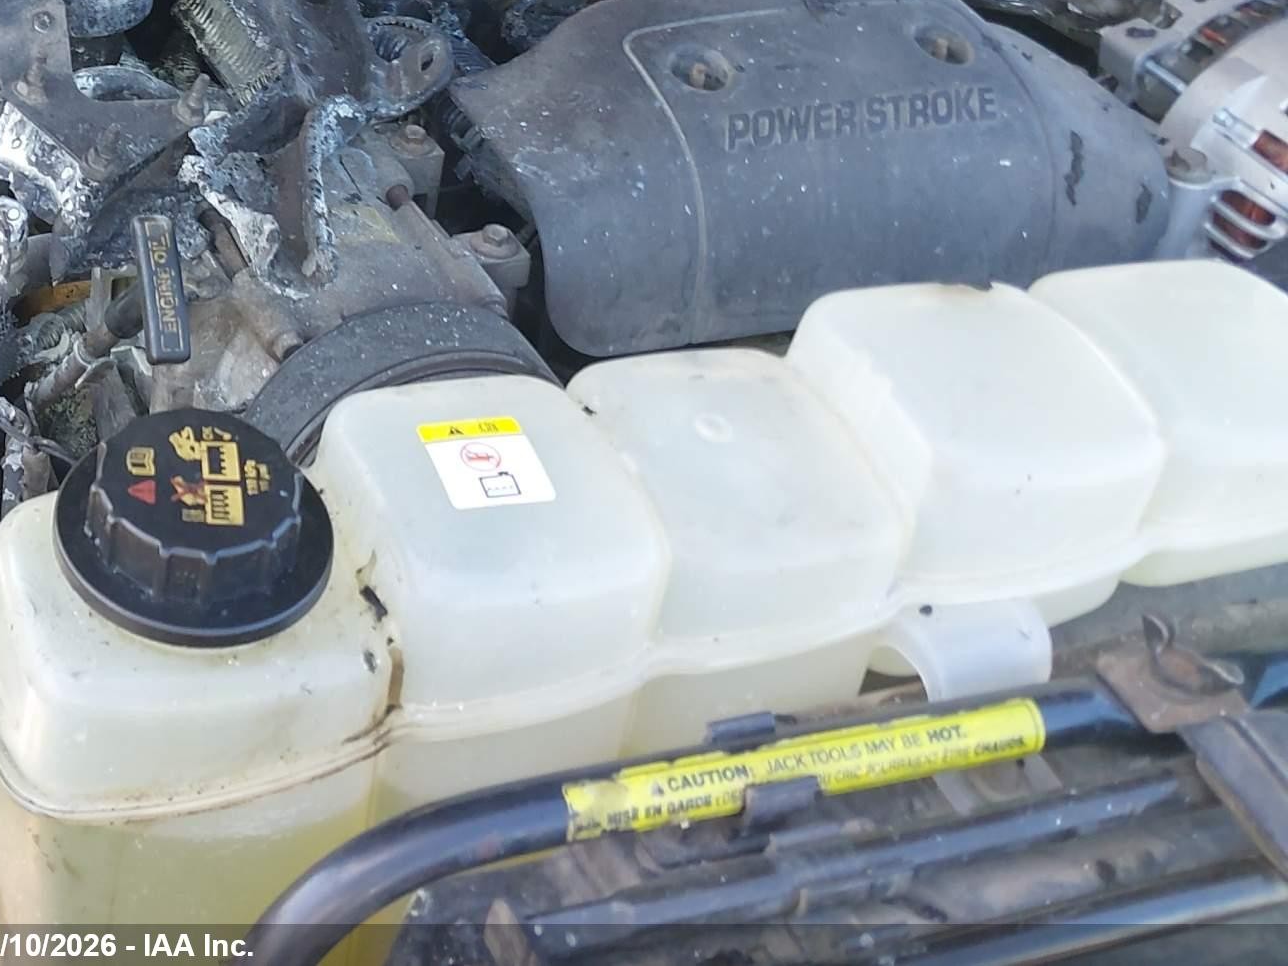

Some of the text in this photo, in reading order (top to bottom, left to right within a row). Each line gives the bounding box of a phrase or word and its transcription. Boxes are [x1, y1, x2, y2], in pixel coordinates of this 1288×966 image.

[726, 87, 997, 152] POWER STROKE
[152, 234, 179, 334] ENGINE OIL
[666, 764, 755, 793] CAUTION:
[766, 753, 809, 773] JACK
[808, 743, 862, 765] TOOLS
[864, 737, 897, 755] MAY
[899, 733, 922, 749] BE
